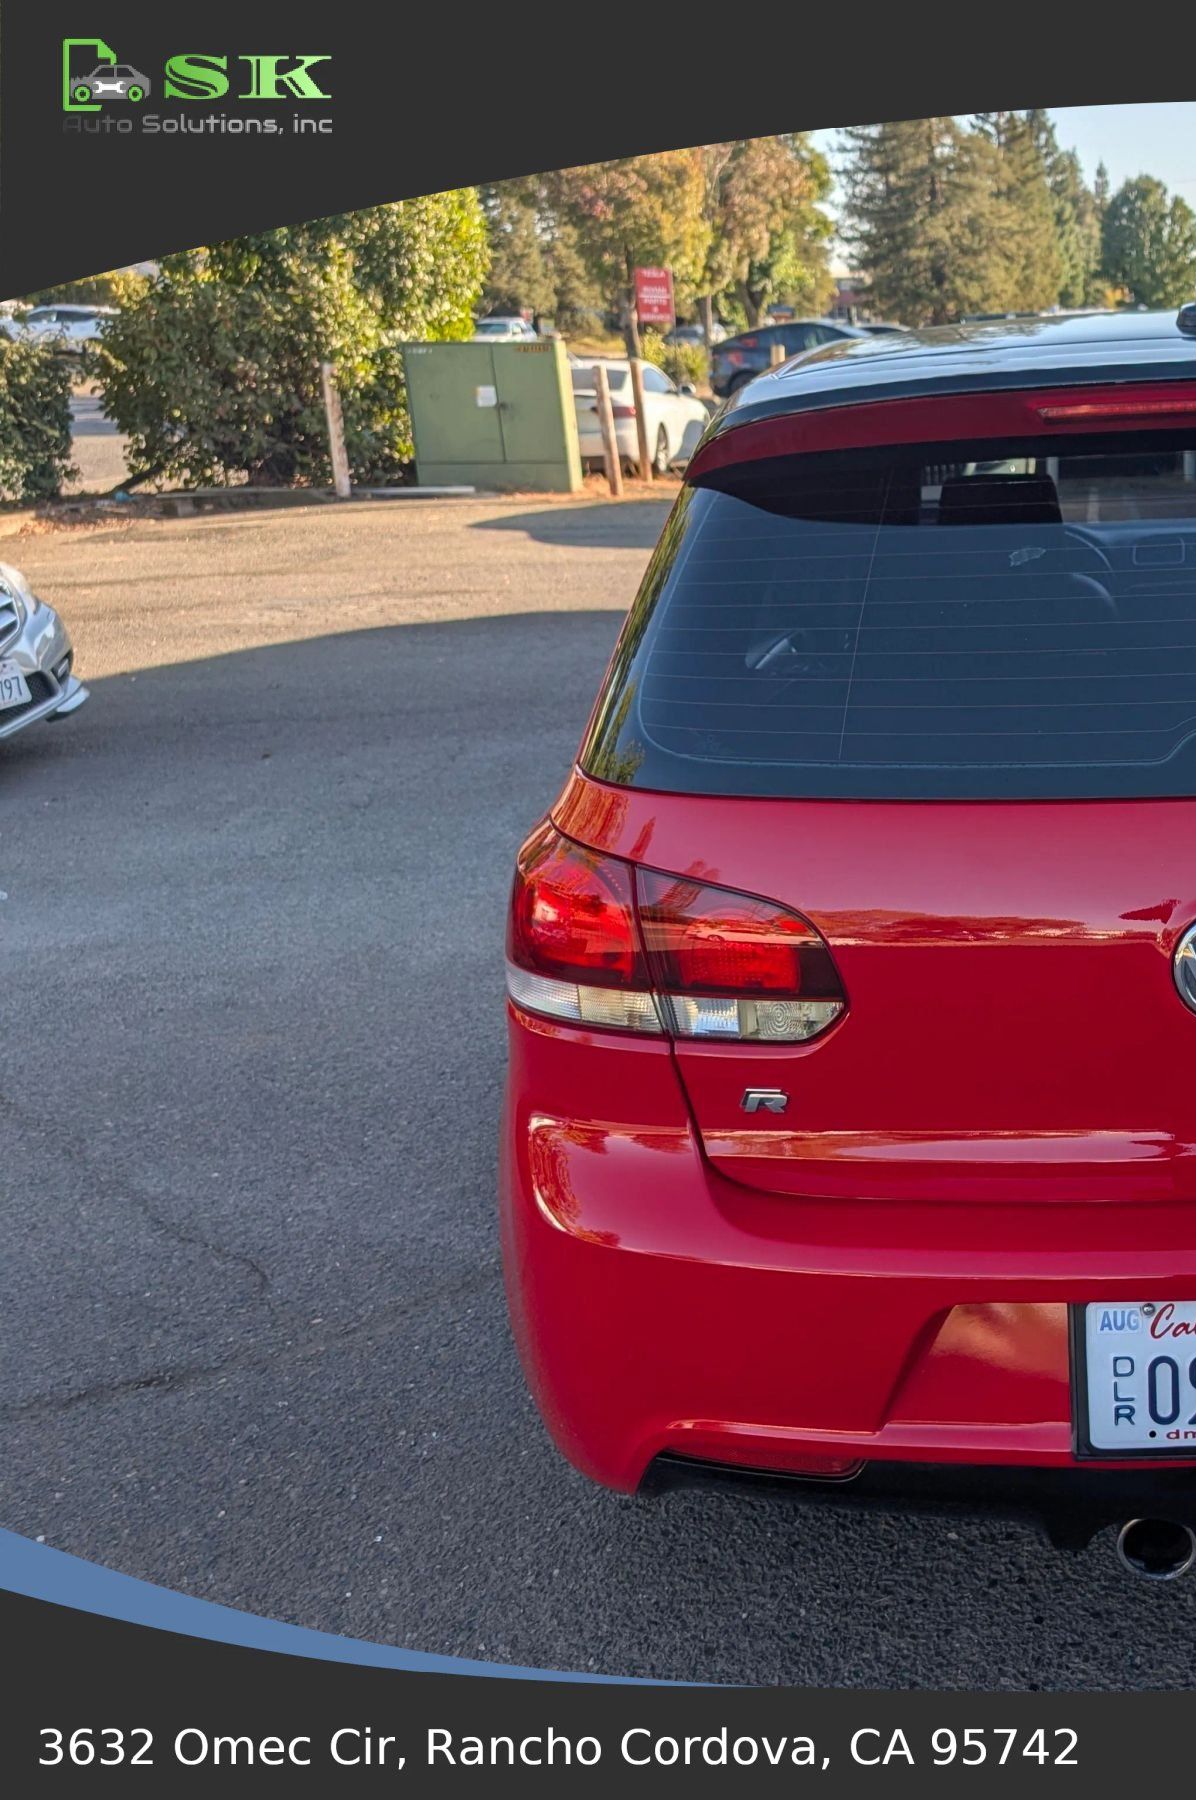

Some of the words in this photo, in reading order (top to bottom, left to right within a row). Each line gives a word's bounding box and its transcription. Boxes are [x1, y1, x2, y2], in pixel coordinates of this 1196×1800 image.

[741, 1088, 788, 1113] R
[1100, 1310, 1139, 1331] AUG
[1112, 1355, 1136, 1426] DLR
